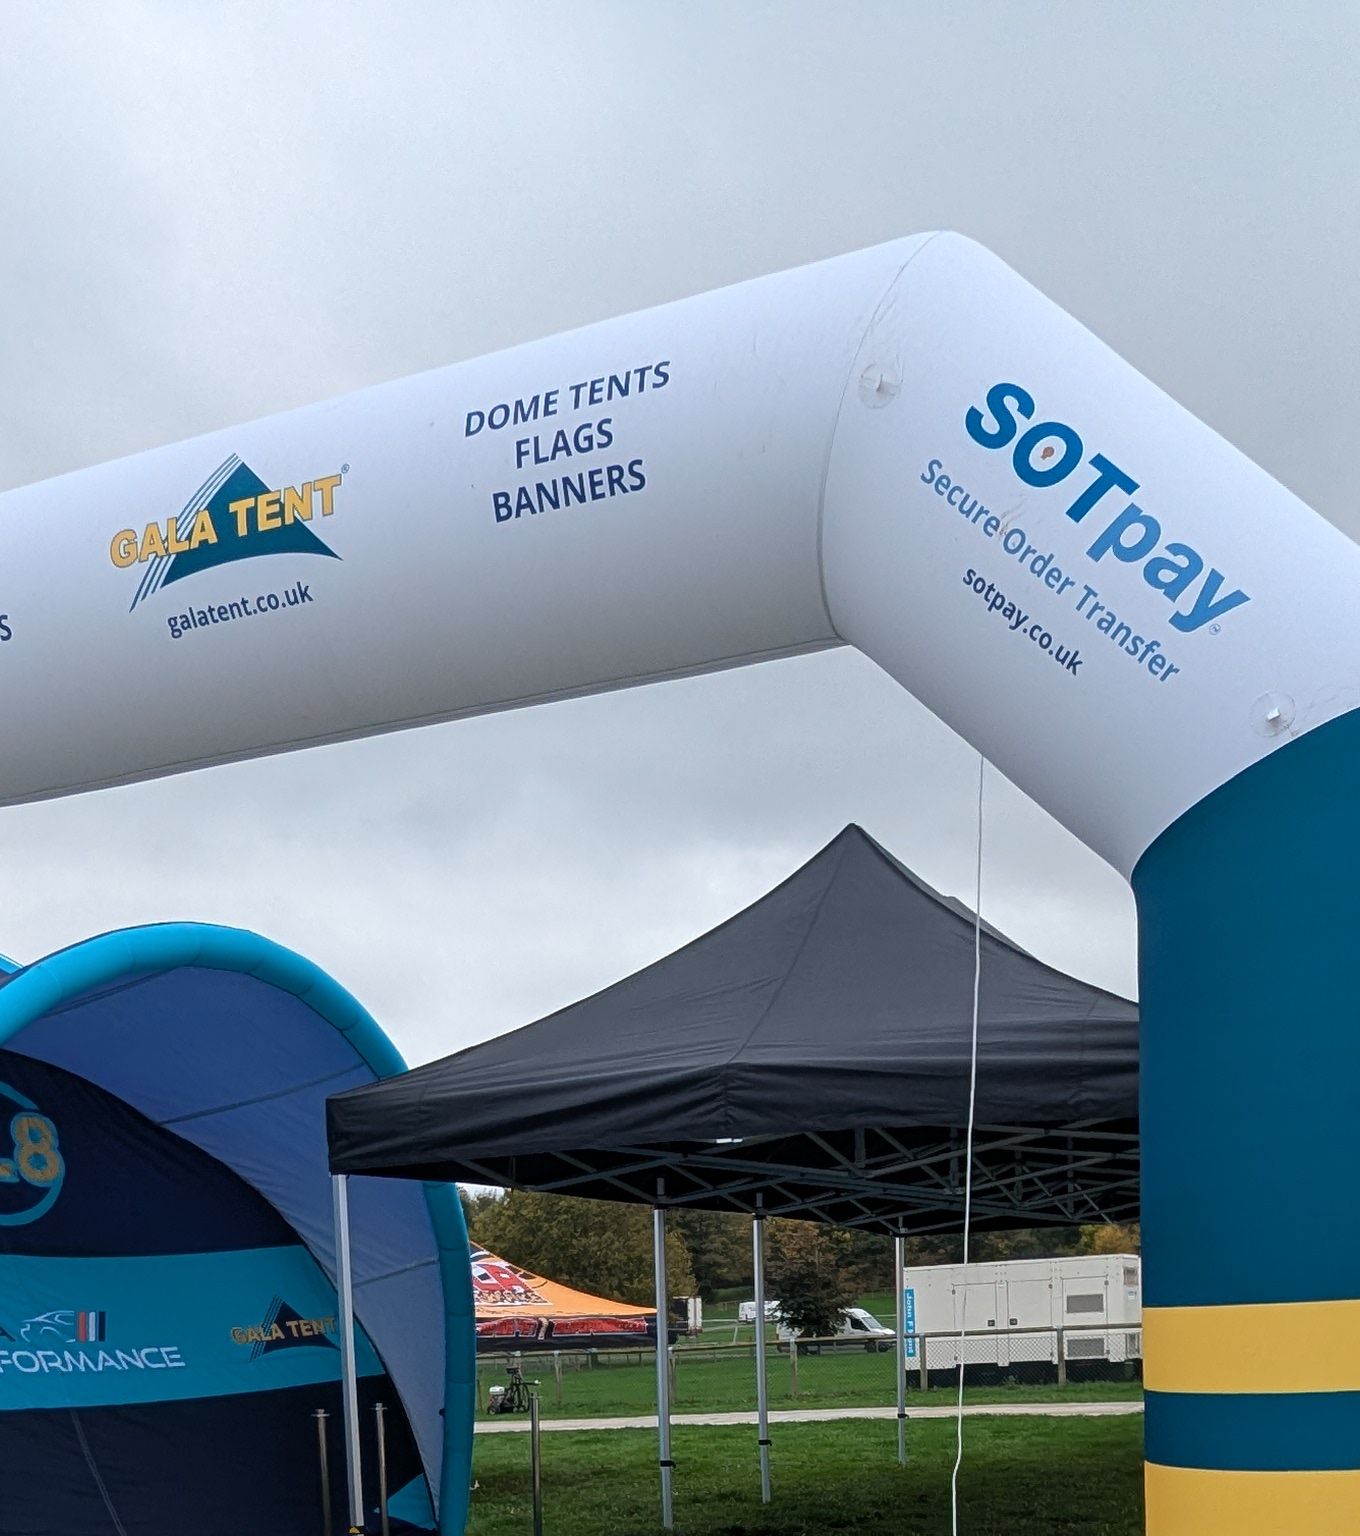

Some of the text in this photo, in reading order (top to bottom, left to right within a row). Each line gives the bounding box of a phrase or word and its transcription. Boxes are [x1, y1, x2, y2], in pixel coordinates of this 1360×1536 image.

[464, 360, 671, 438] DOME TENTS
[515, 417, 614, 470] FLAGS
[110, 473, 342, 568] GALA TENT
[492, 458, 647, 523] BANNERS
[965, 382, 1251, 633] SOTpay
[920, 459, 1181, 682] Secure Order Transfer
[167, 581, 314, 639] galatent.co.uk
[962, 568, 1084, 676] sotpay.co.uk
[231, 1316, 335, 1345] GALA TENT
